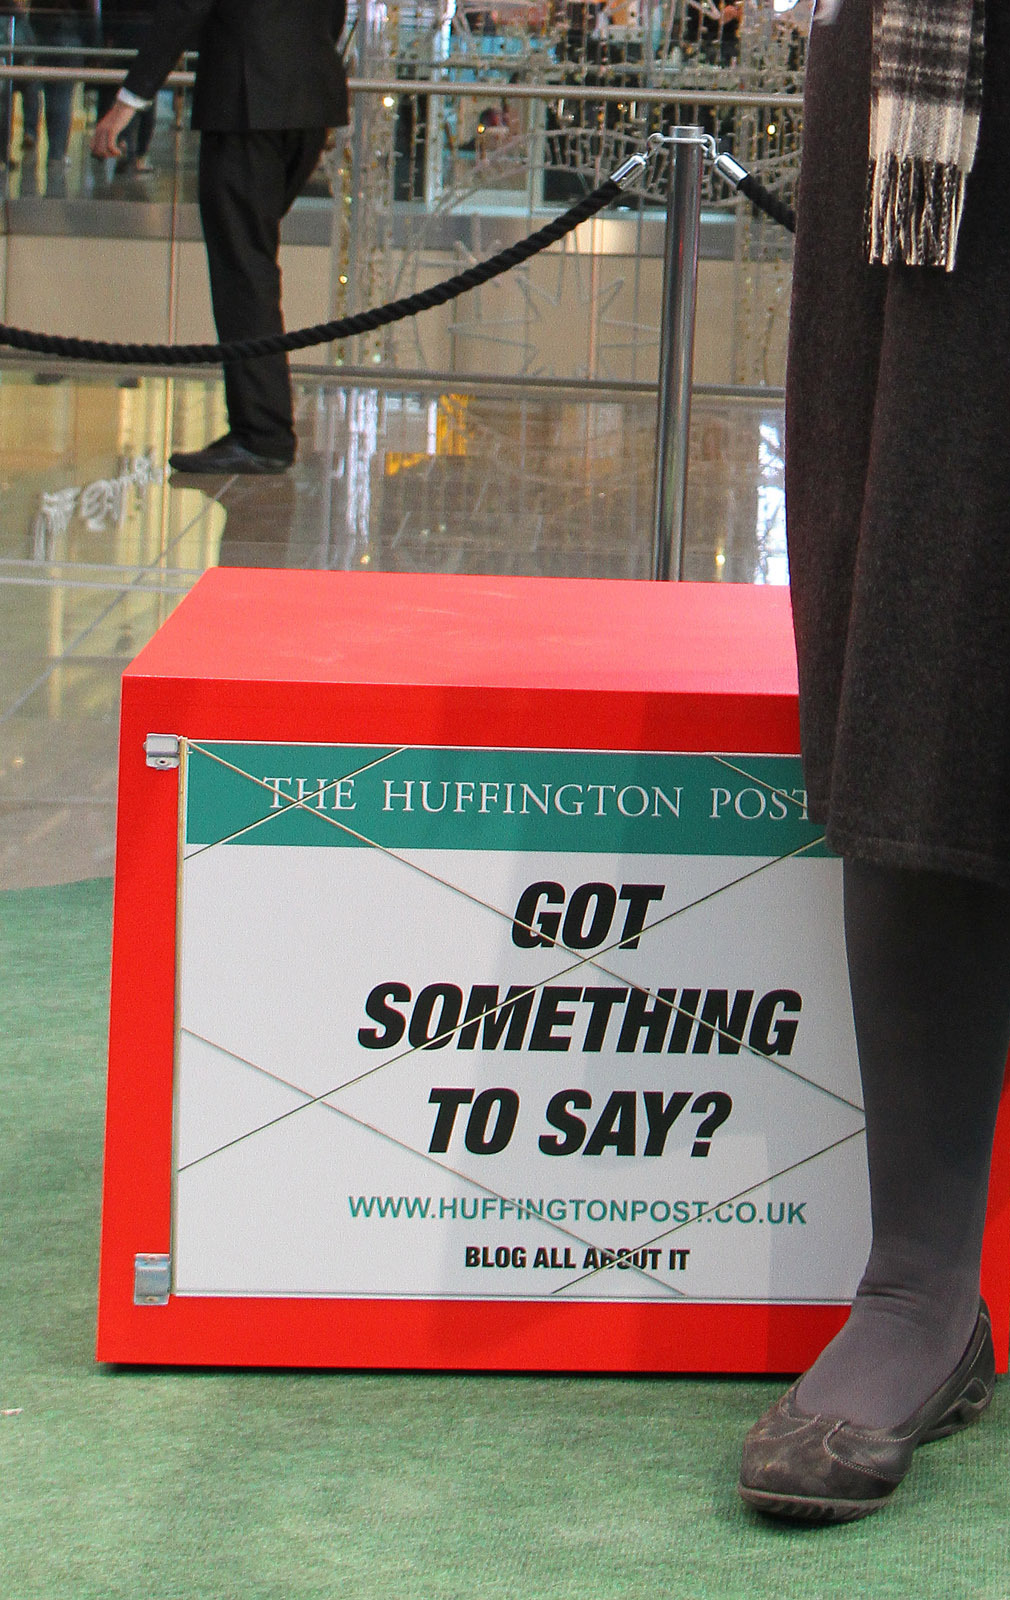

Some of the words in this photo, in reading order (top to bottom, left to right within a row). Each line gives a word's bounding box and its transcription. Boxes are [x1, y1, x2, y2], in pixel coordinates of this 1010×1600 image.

[262, 776, 357, 811] THE
[382, 778, 684, 818] HUFFINGTON
[708, 786, 809, 820] POST
[511, 880, 665, 951] GOT
[357, 981, 803, 1057] SOMETHING
[427, 1086, 520, 1156] TO
[538, 1088, 733, 1159] SAY?
[347, 1196, 808, 1226] WWW.HUFFINGTONPOST.CO.UK
[465, 1245, 527, 1270] BLOG
[532, 1246, 577, 1270] ALL
[583, 1247, 663, 1271] ABOUT
[668, 1249, 691, 1272] IT
